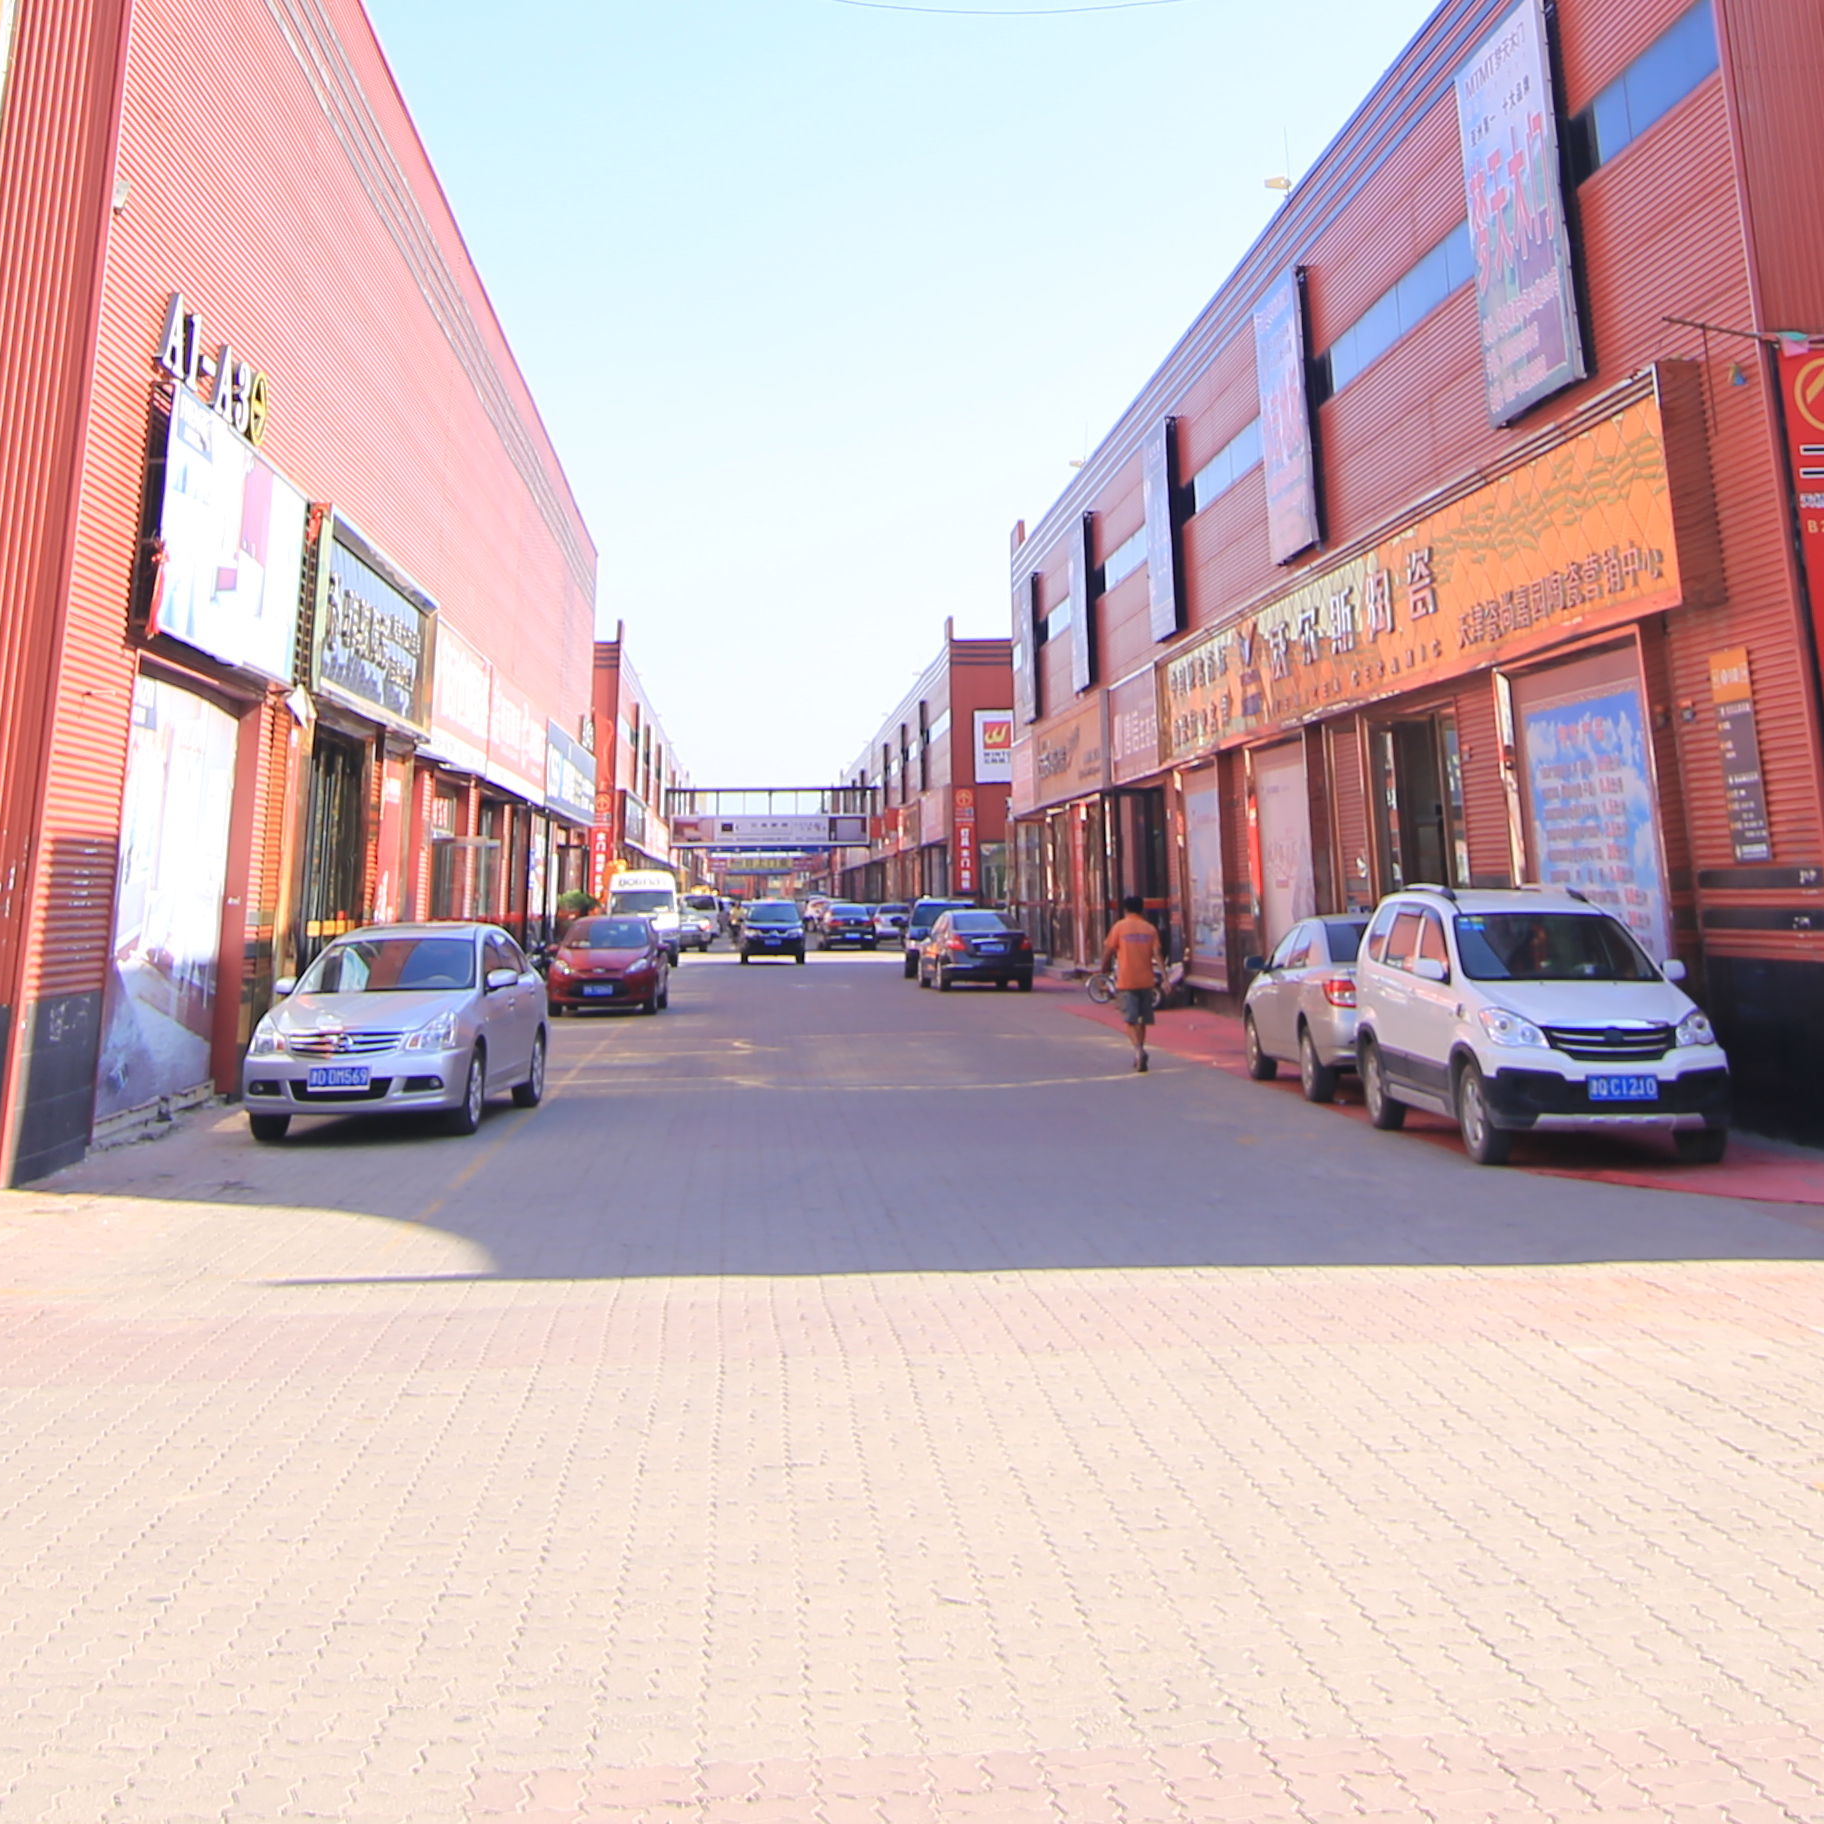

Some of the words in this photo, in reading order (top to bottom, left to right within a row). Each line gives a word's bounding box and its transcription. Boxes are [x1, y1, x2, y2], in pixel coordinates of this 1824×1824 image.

[1468, 110, 1555, 297] 梦天木门
[156, 292, 253, 434] A1-A3
